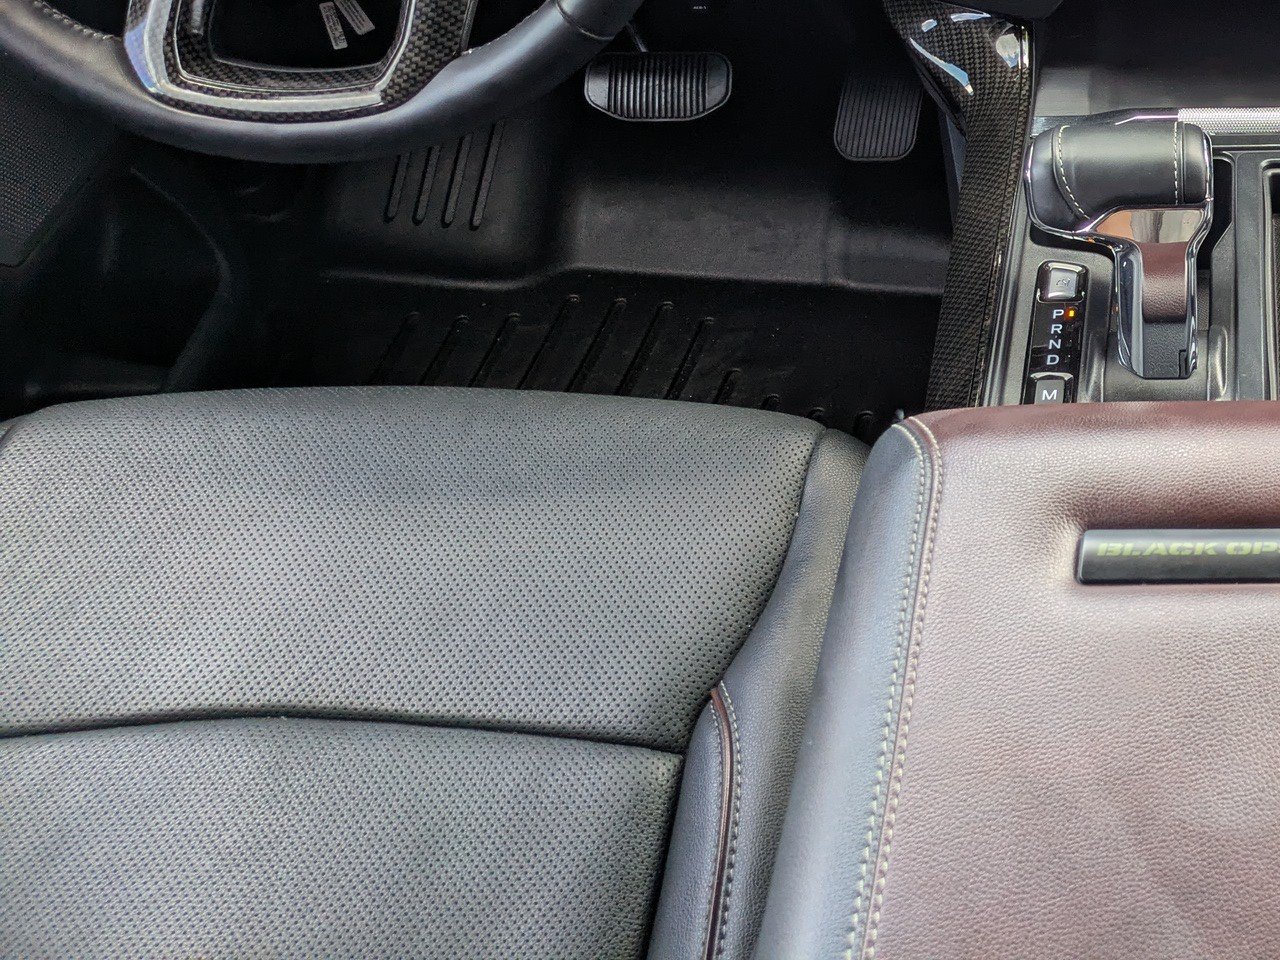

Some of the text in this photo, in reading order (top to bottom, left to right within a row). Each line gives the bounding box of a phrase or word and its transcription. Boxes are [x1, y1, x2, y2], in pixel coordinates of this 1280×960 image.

[1053, 309, 1065, 319] P
[1051, 323, 1062, 335] R
[1048, 339, 1061, 350] N
[1046, 354, 1060, 366] D
[1042, 389, 1058, 400] M
[1097, 542, 1218, 556] BLACK
